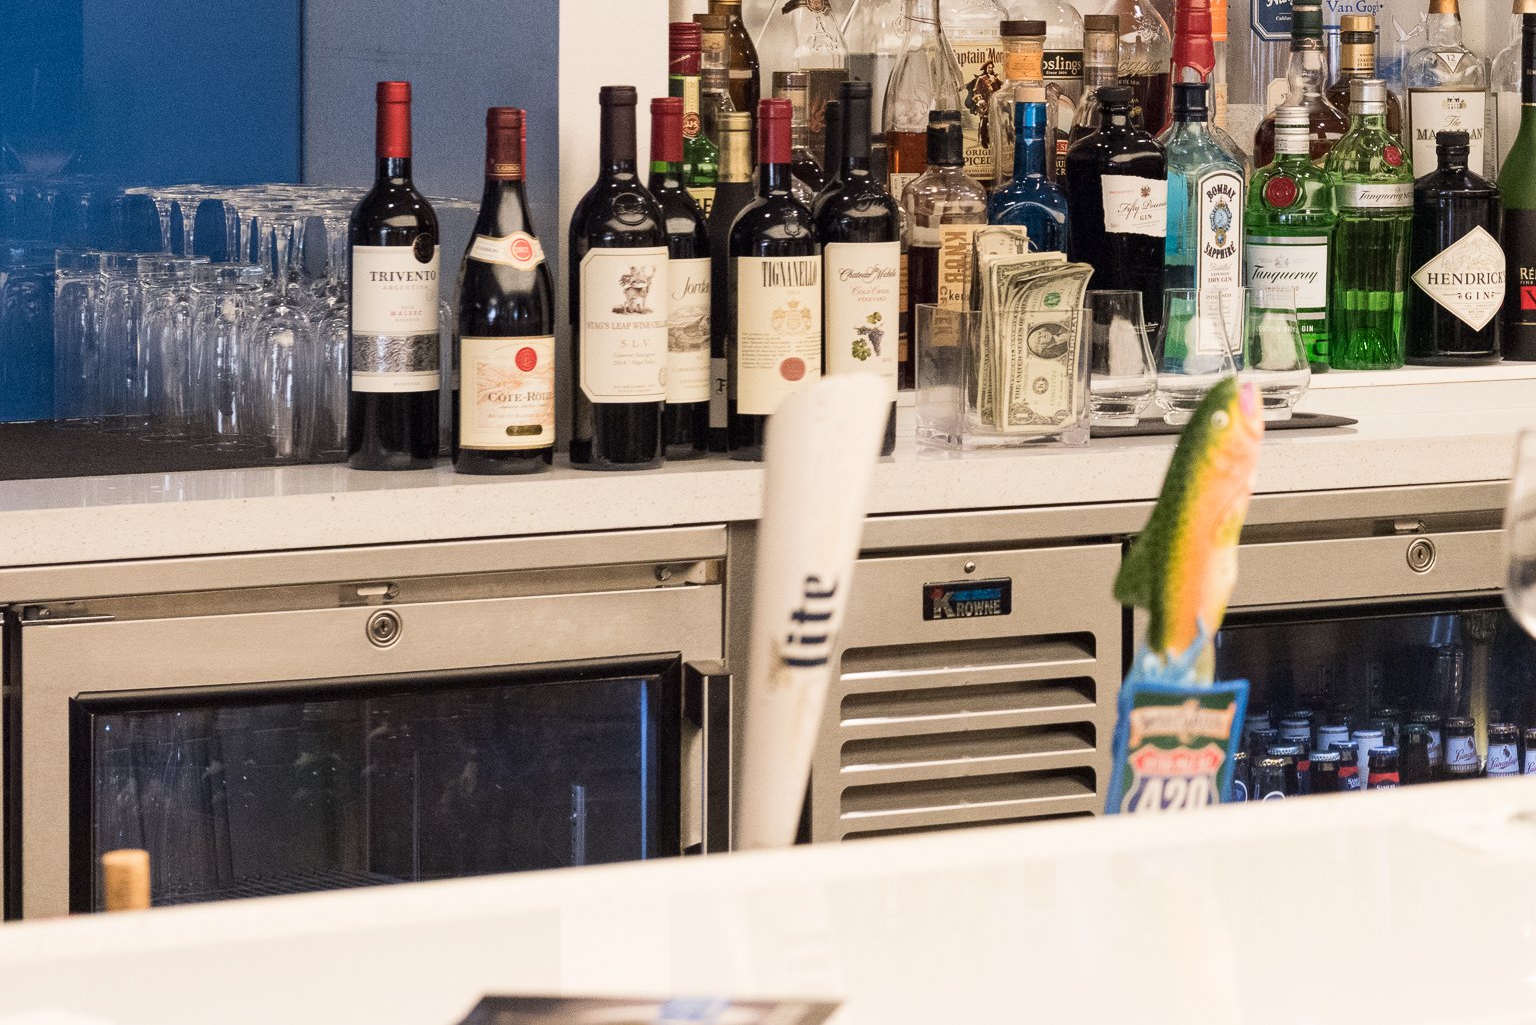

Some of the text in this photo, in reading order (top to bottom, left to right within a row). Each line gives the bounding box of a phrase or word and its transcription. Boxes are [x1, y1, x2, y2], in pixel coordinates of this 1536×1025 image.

[1327, 0, 1353, 13] Van
[1446, 54, 1456, 62] 12
[1206, 183, 1236, 202] BOMBAY
[1358, 190, 1402, 203] Tanqueray
[1117, 200, 1140, 220] Fifty
[945, 231, 967, 283] KNOB
[1204, 241, 1236, 259] SAPPHIRE
[369, 270, 437, 281] TRIVENTO
[1252, 264, 1318, 283] Tanqueray
[1464, 291, 1490, 300] GIN
[1068, 310, 1077, 352] DOLLAR
[1016, 327, 1024, 355] STATES
[1015, 355, 1024, 384] UNITED
[933, 592, 1001, 619] KROWNE
